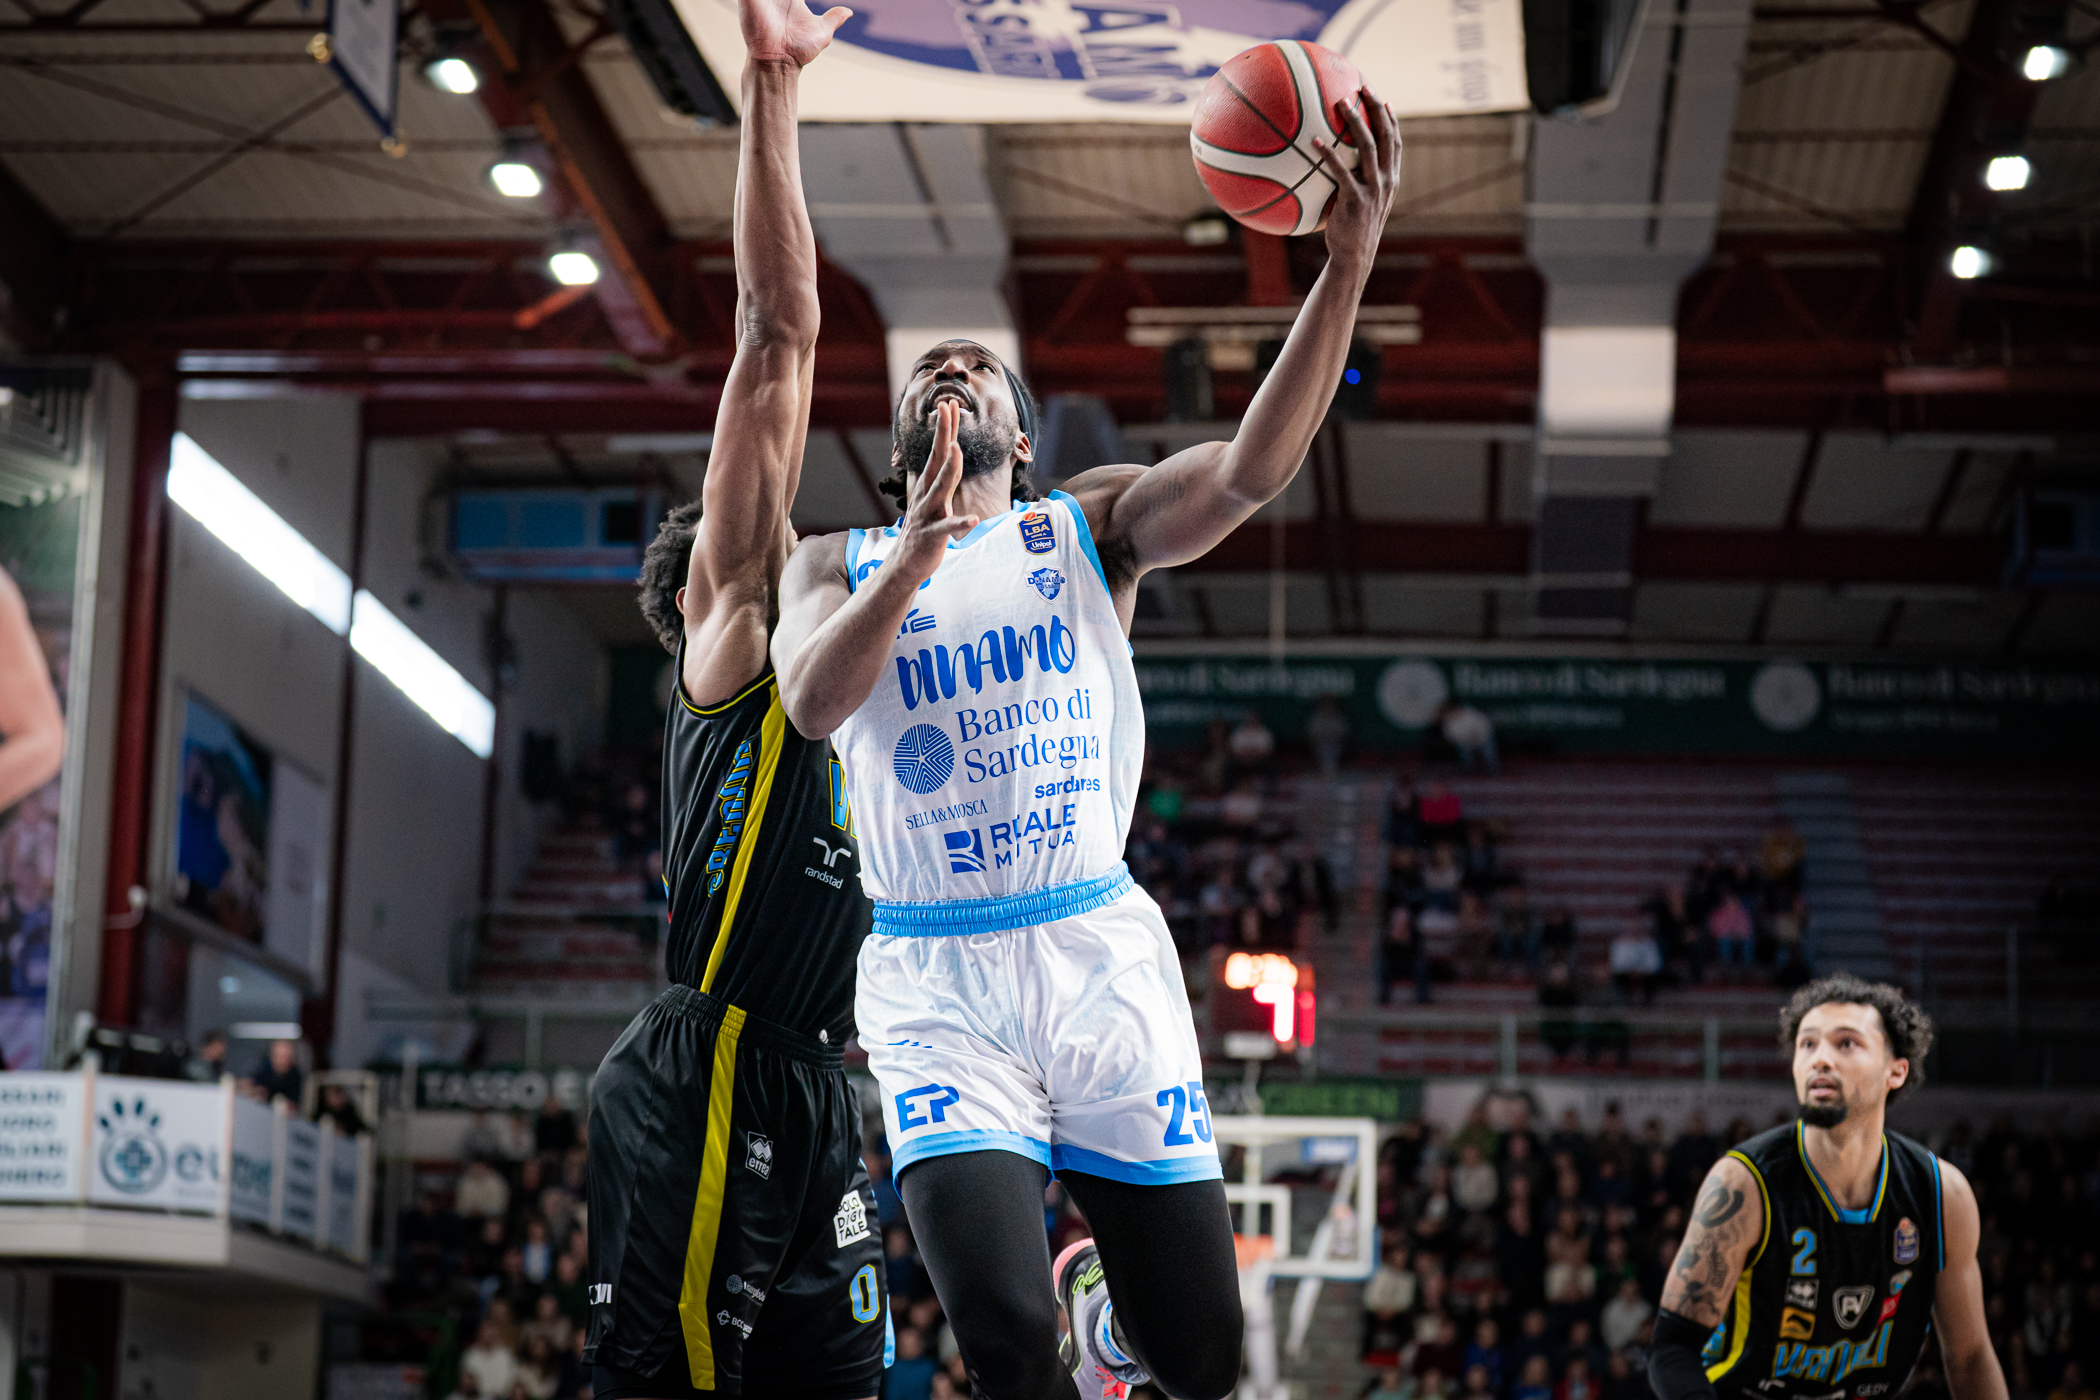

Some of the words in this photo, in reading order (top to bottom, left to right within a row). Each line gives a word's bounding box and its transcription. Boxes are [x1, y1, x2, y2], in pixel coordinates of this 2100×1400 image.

[1024, 523, 1050, 536] LBA
[895, 614, 1076, 712] DINAMO
[954, 696, 1060, 744] Banco
[1067, 688, 1092, 720] di
[963, 733, 1101, 784] Sardegna
[804, 865, 844, 890] randstad
[1156, 1080, 1213, 1147] 25
[839, 1220, 866, 1242] TALE
[1790, 1227, 1818, 1277] 2
[849, 1263, 880, 1324] 0
